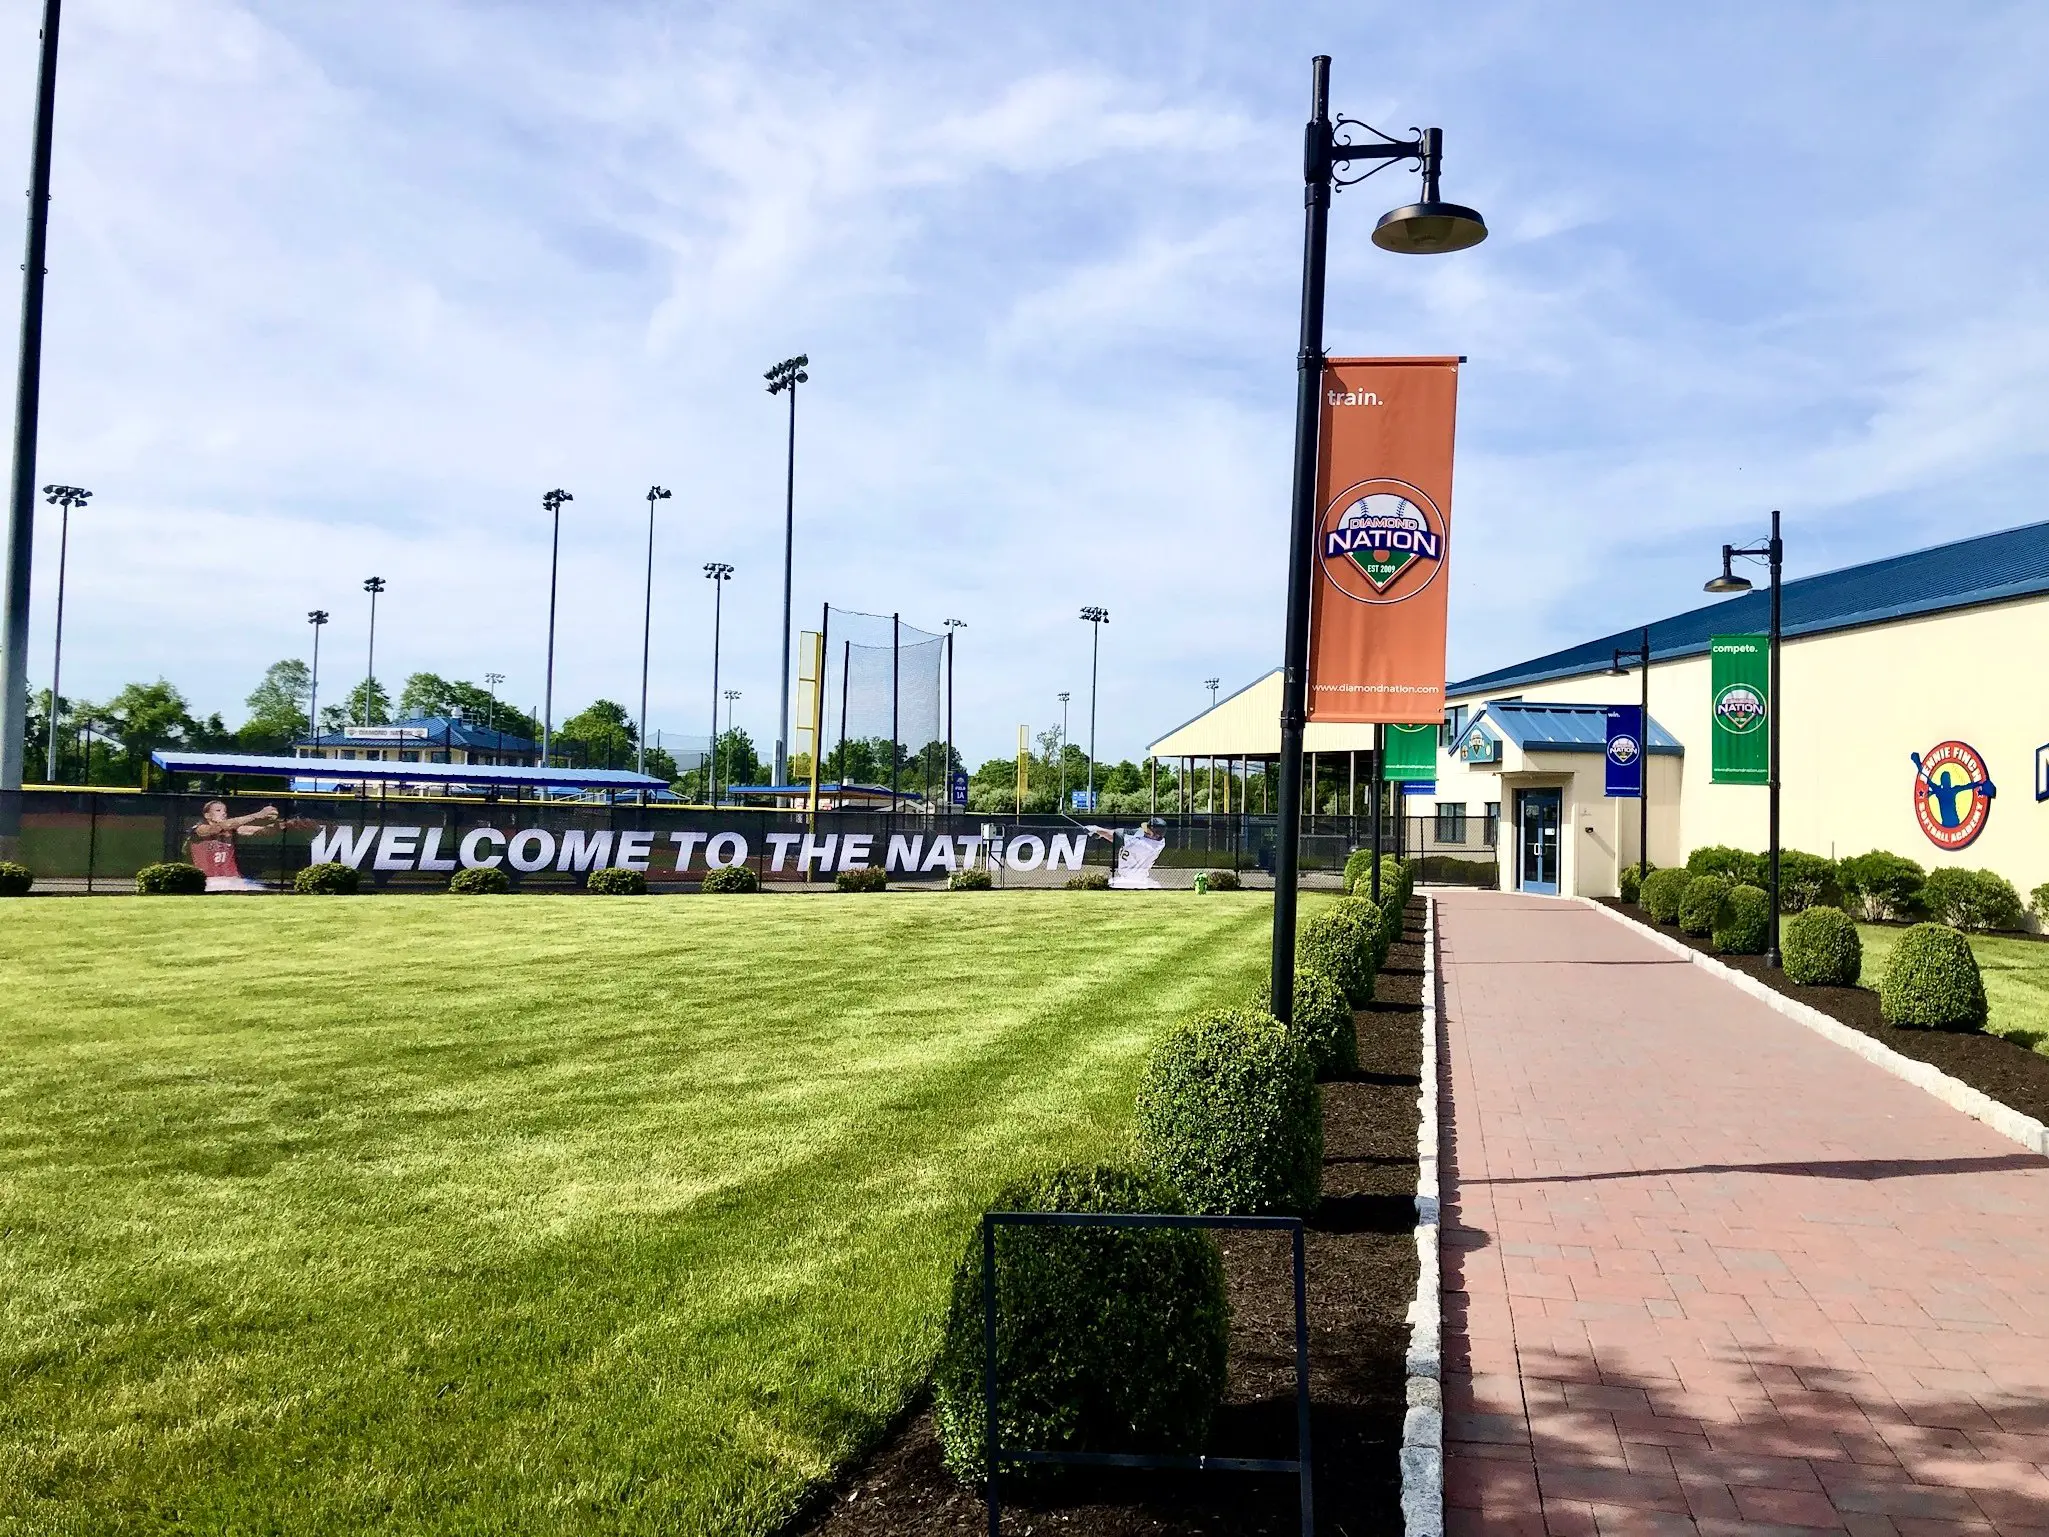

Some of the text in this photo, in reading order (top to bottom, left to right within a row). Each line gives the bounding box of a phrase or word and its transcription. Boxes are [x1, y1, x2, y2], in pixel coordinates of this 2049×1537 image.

[1327, 387, 1384, 406] train.
[1349, 517, 1418, 530] DIAMOND
[1327, 528, 1437, 557] NATION
[1367, 564, 1396, 574] EST 2009
[1712, 644, 1759, 655] compete.
[1312, 683, 1440, 694] www.diamondnation.com
[1717, 703, 1764, 715] NATION
[1609, 747, 1638, 755] NATION
[1953, 746, 1982, 783] FINCH
[1918, 801, 1983, 843] SOFTBALL ACADEMY
[311, 825, 1088, 872] WELCOME TO THE NATION
